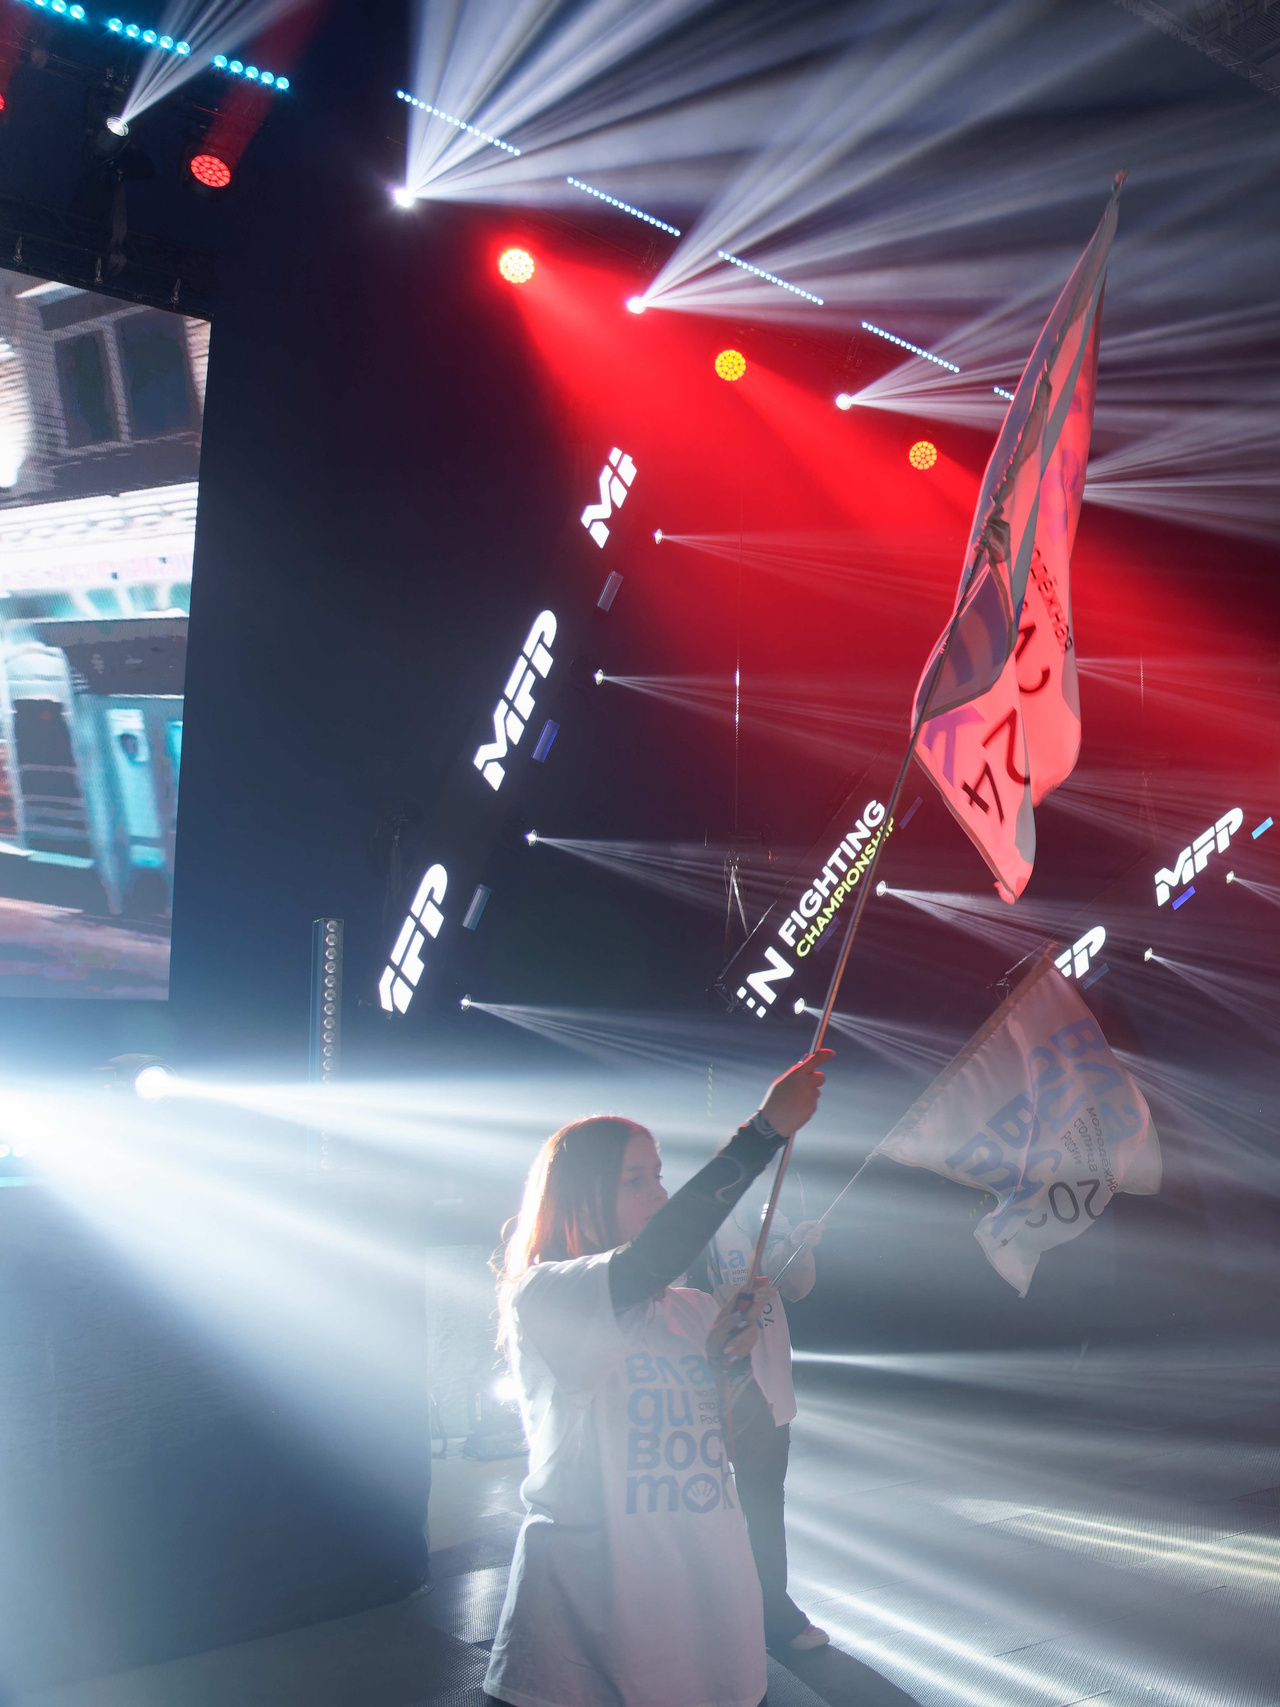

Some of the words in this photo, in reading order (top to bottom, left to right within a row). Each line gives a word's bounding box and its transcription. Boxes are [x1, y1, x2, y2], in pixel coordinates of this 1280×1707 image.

[473, 609, 557, 791] MFP
[778, 799, 886, 947] FIGHTING
[1154, 807, 1244, 907] MFP
